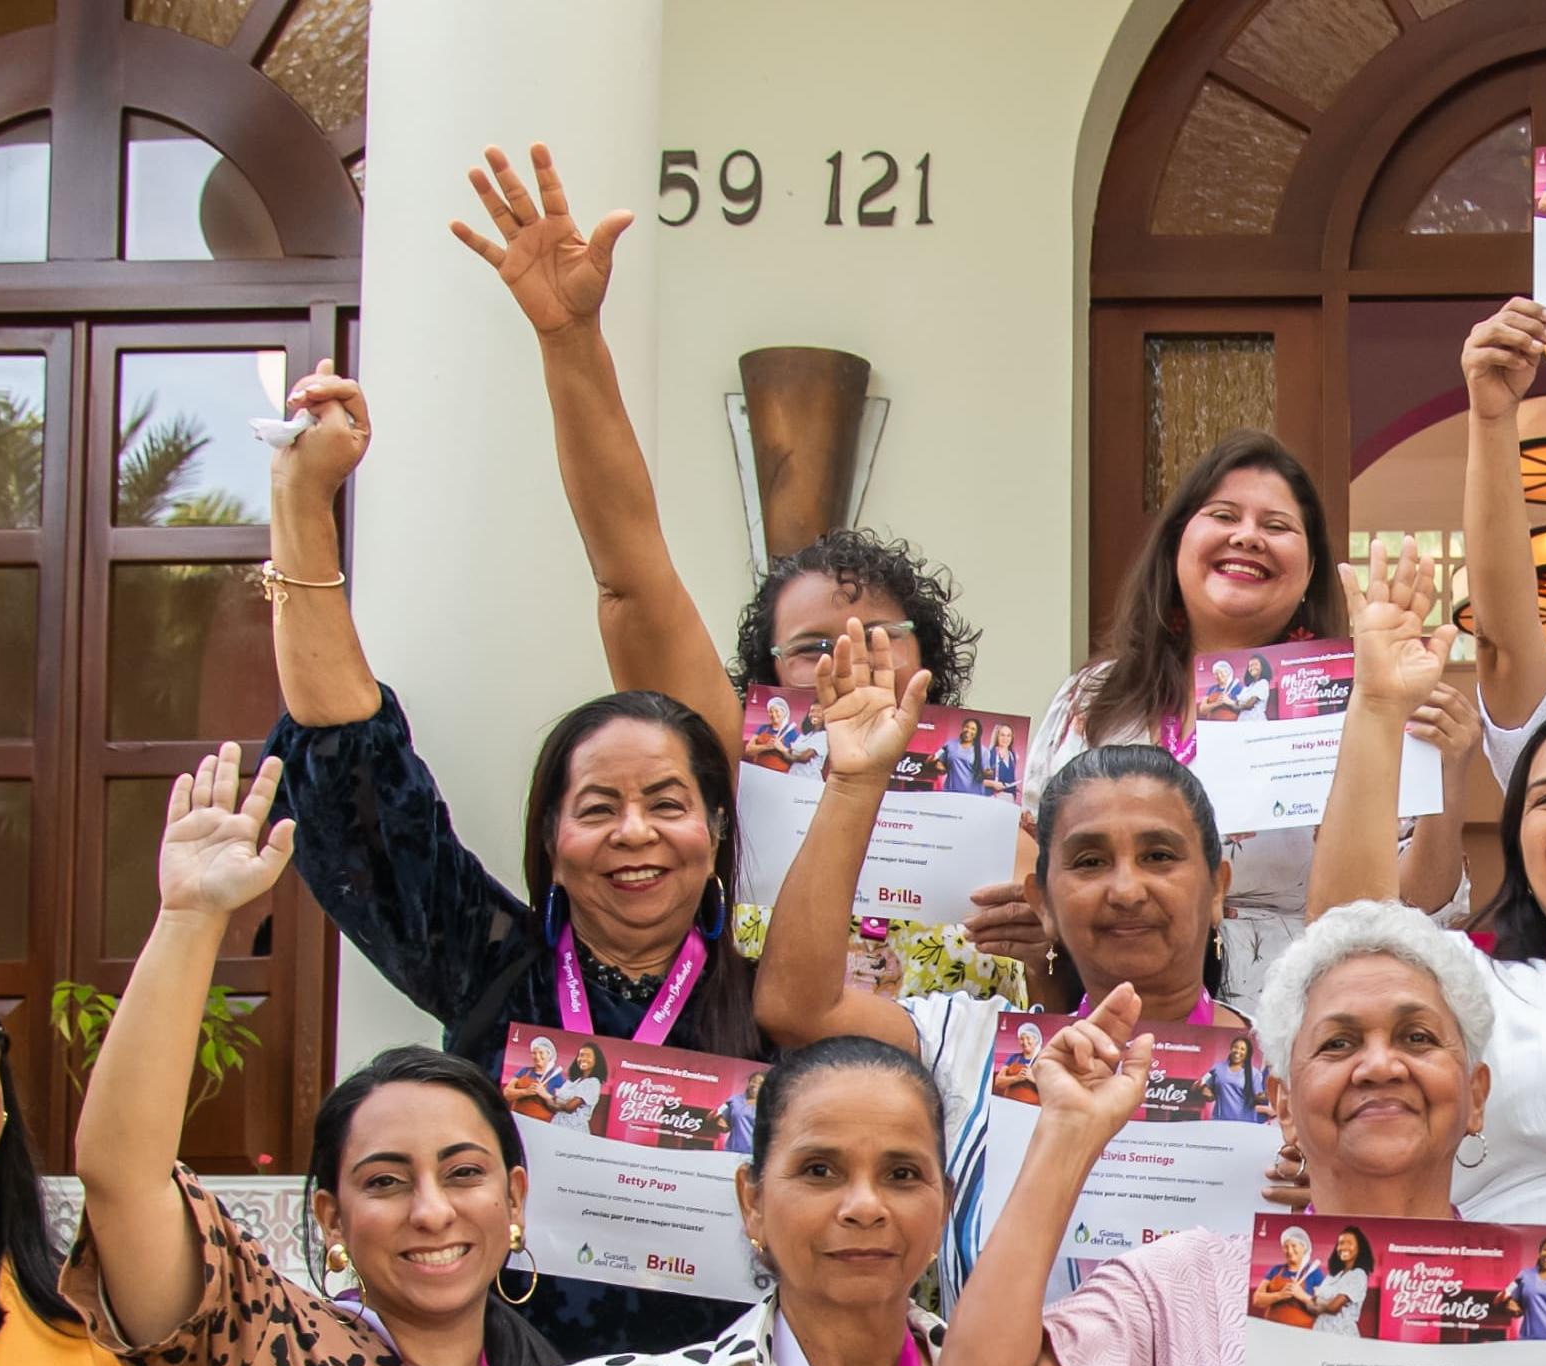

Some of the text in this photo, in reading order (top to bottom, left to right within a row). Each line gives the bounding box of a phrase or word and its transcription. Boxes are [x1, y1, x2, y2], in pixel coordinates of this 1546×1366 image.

[658, 149, 934, 227] 59 121
[1286, 683, 1349, 705] Brillantes
[879, 887, 922, 905] Brilla
[616, 1081, 682, 1109] Mujeres
[619, 1100, 703, 1132] Brillantes
[1129, 1152, 1174, 1166] Santiago
[618, 1174, 677, 1192] Betty Pupo
[647, 1254, 695, 1275] Brilla
[1414, 1262, 1454, 1278] Premio
[1386, 1269, 1463, 1298] Mujeres
[1391, 1293, 1489, 1320] Brillantes
